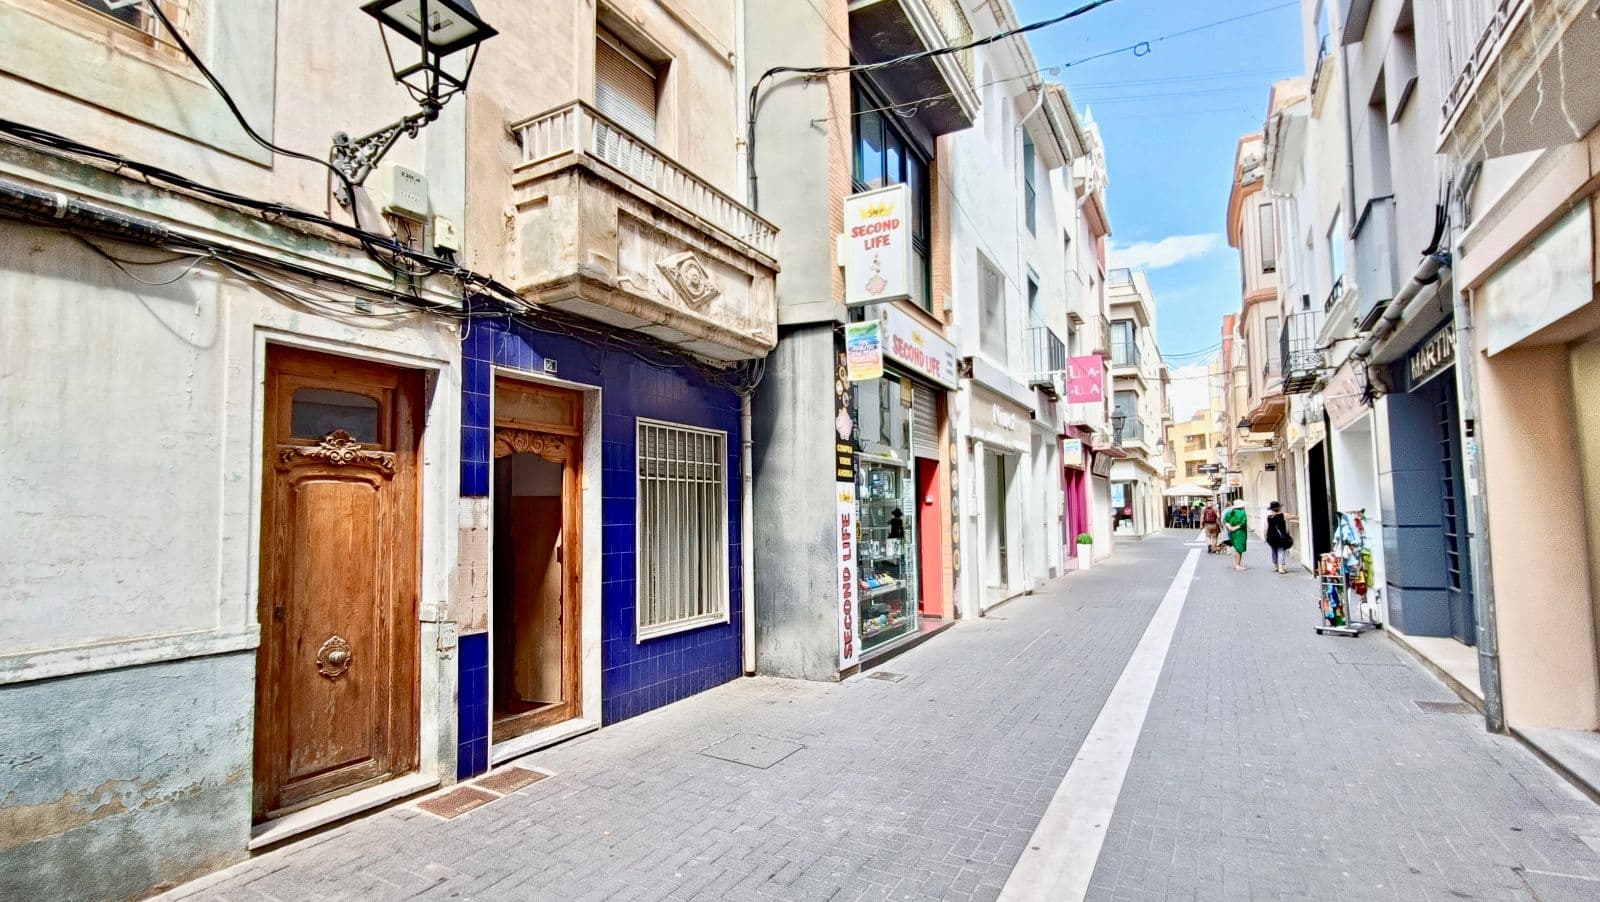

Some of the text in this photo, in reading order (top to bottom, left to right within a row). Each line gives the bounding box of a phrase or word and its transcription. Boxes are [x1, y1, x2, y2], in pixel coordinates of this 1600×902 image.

[851, 218, 900, 239] SECOND
[864, 234, 890, 251] LIFE
[893, 333, 924, 368] SECOND
[926, 354, 940, 378] LIFE
[841, 513, 851, 562] LIFE
[843, 566, 853, 660] SECOND
